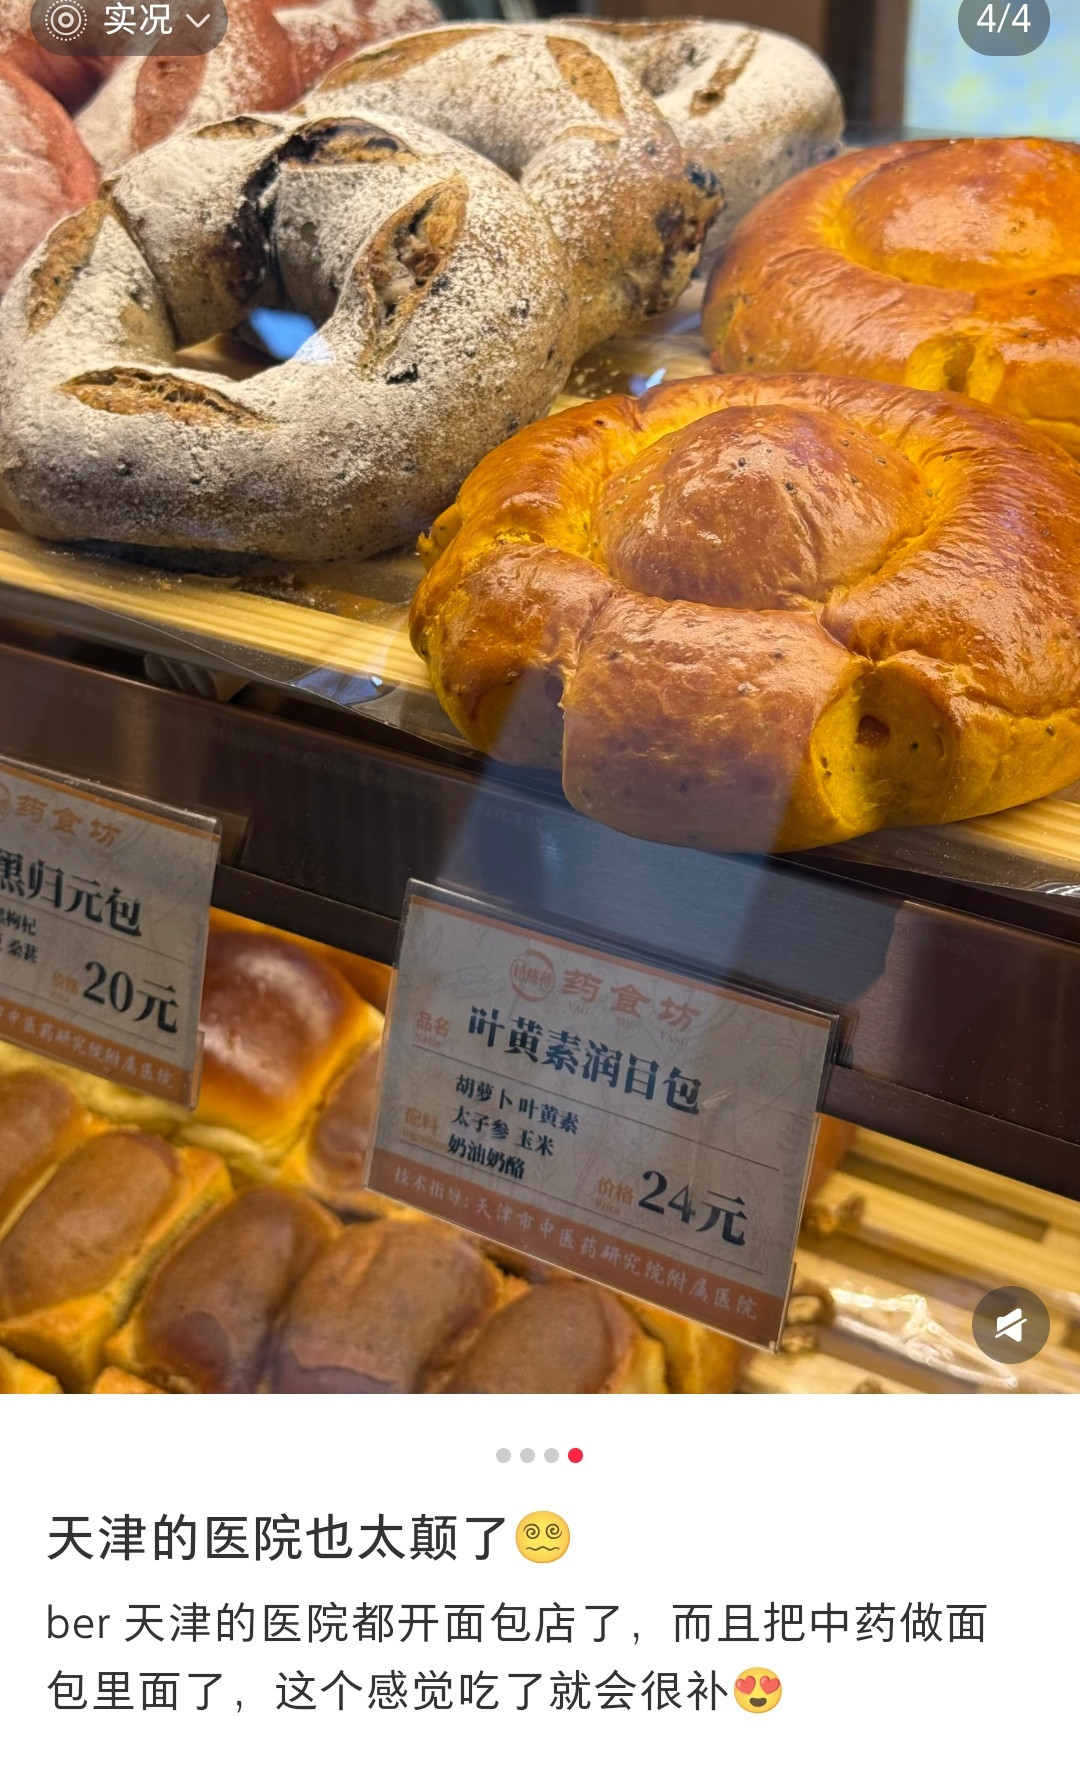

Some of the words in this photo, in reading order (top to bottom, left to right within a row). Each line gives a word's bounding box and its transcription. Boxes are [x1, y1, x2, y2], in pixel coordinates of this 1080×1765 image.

[15, 794, 122, 847] 药食坊
[83, 960, 178, 1034] 20元
[560, 968, 703, 1032] 药食坊
[415, 1011, 450, 1038] 品名
[468, 1005, 703, 1115] 叶黄素润目包
[404, 1106, 438, 1134] 配料
[451, 1105, 510, 1139] 太子参
[514, 1127, 555, 1157] 玉米
[456, 1074, 513, 1109] 胡萝卜
[518, 1097, 580, 1135] 叶黄素
[446, 1133, 526, 1180] 奶油奶酪
[596, 1176, 635, 1204] 价格
[638, 1169, 747, 1247] 24元
